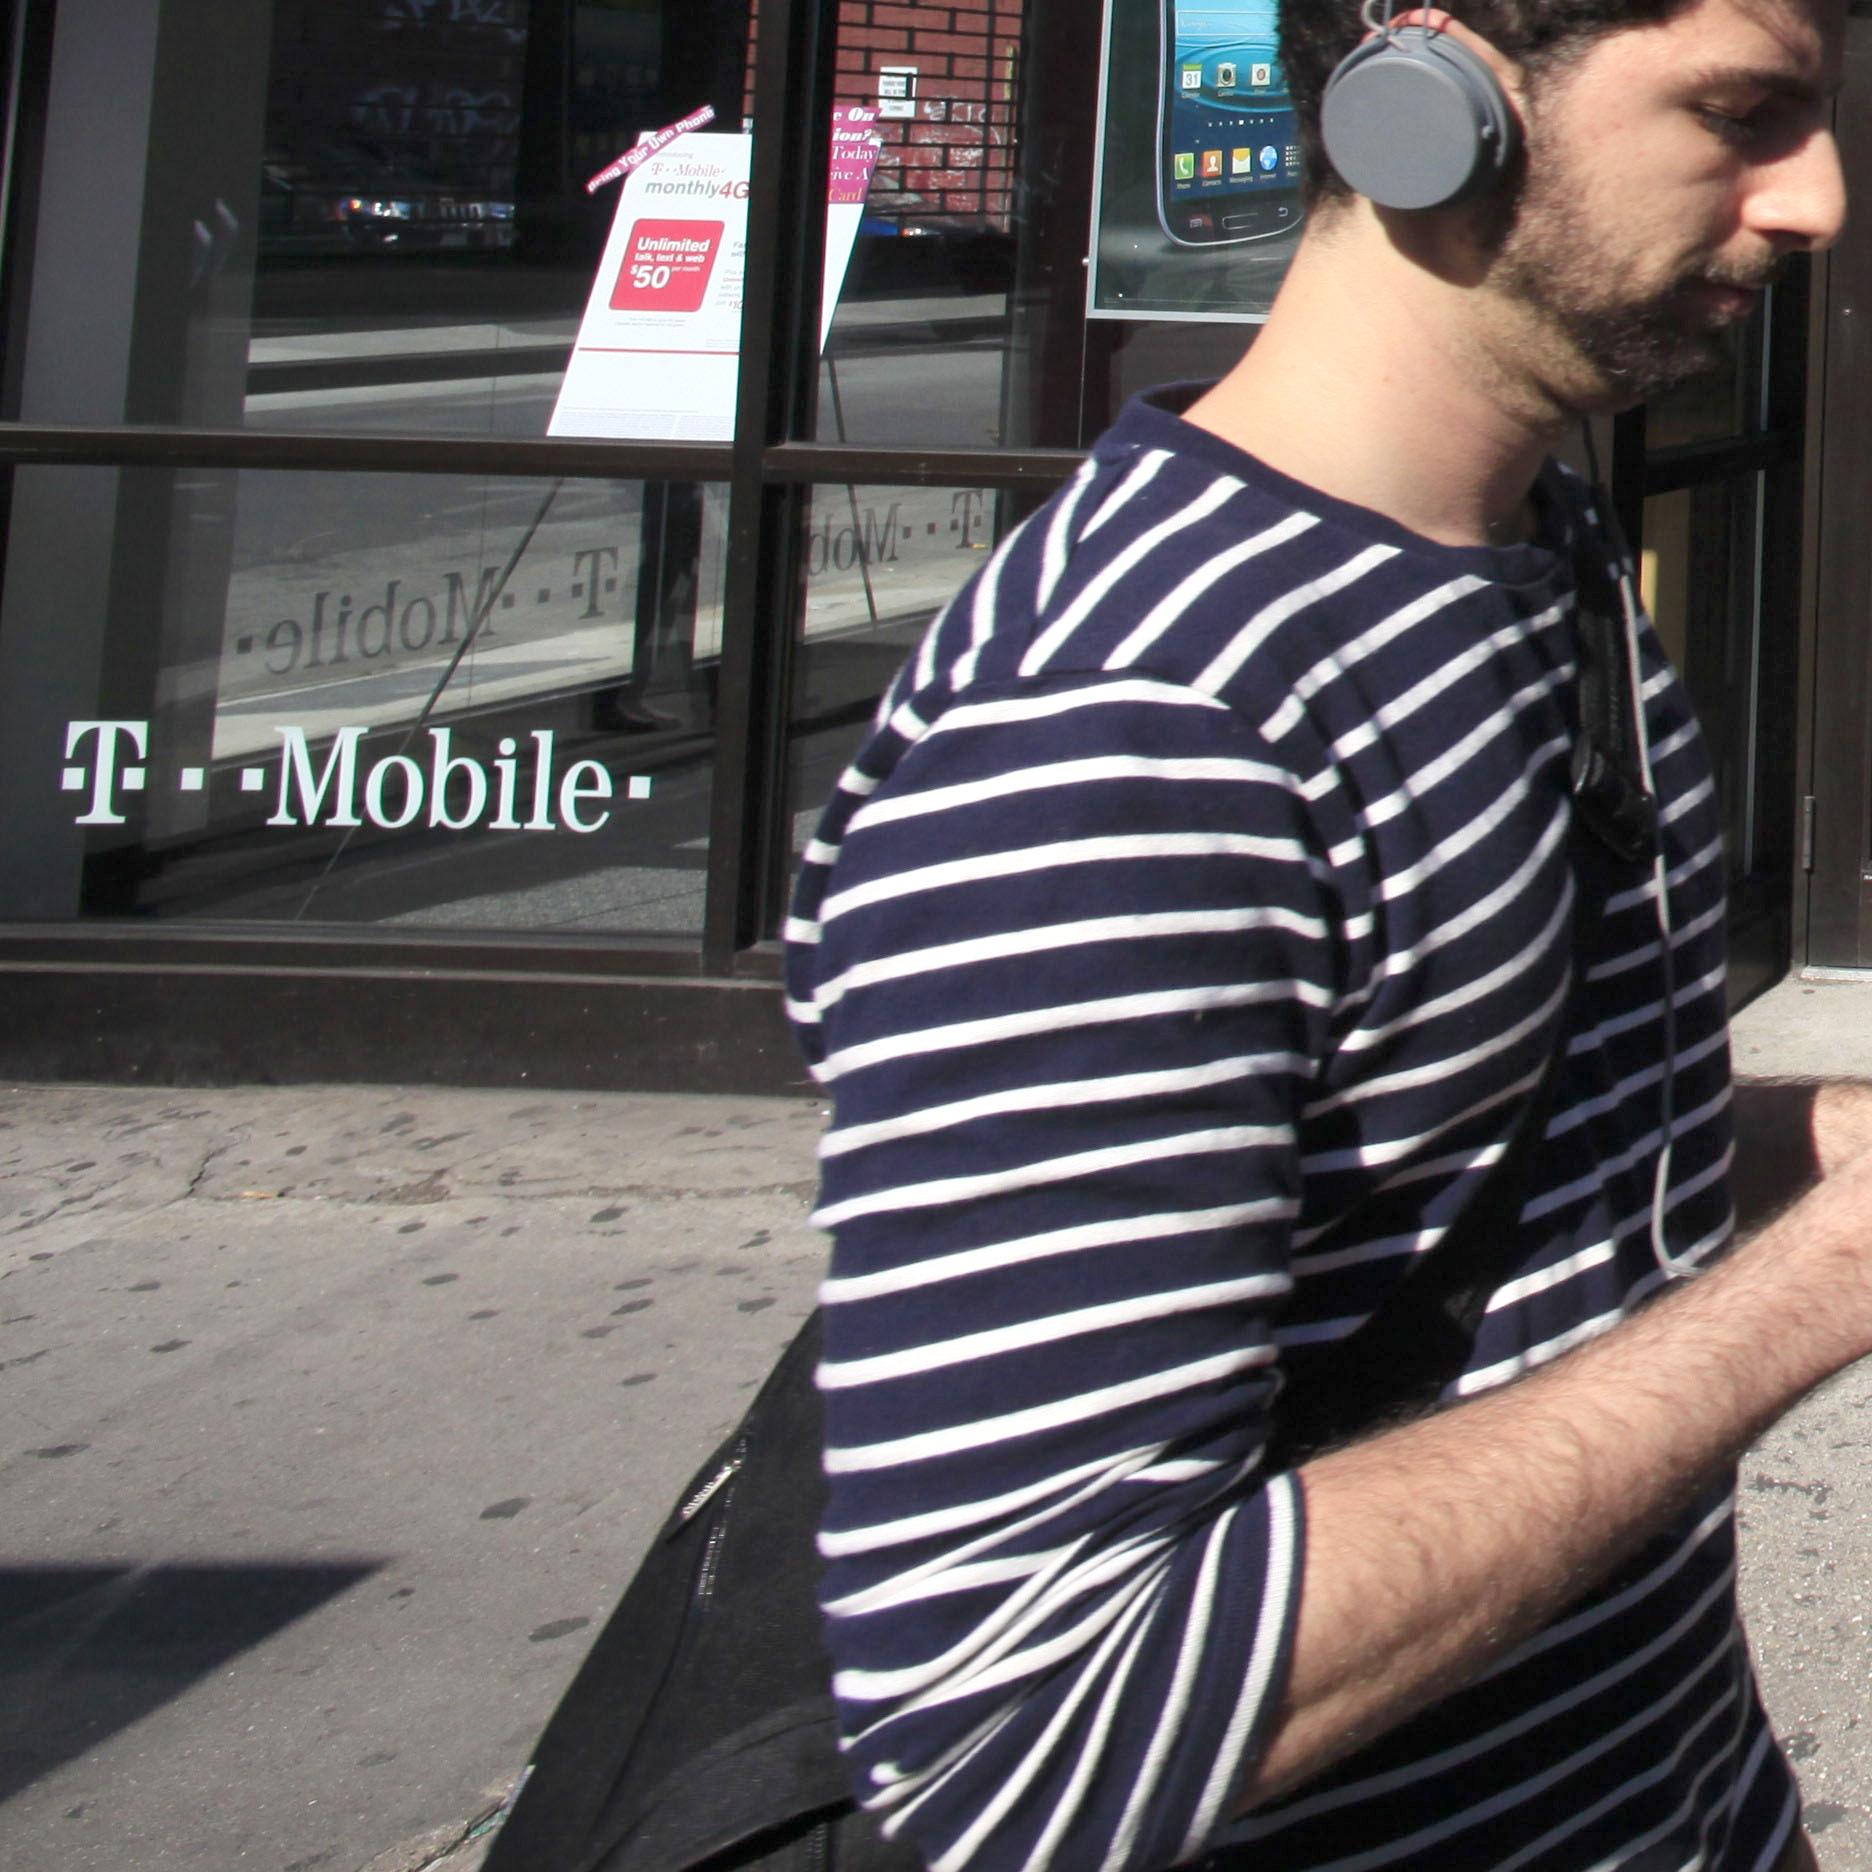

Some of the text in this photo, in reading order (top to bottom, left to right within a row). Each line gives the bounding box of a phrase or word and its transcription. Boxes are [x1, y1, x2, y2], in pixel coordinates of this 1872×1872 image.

[674, 108, 715, 134] Phone
[832, 127, 873, 142] ion?
[637, 236, 712, 253] Unlimited
[629, 264, 672, 289] $50
